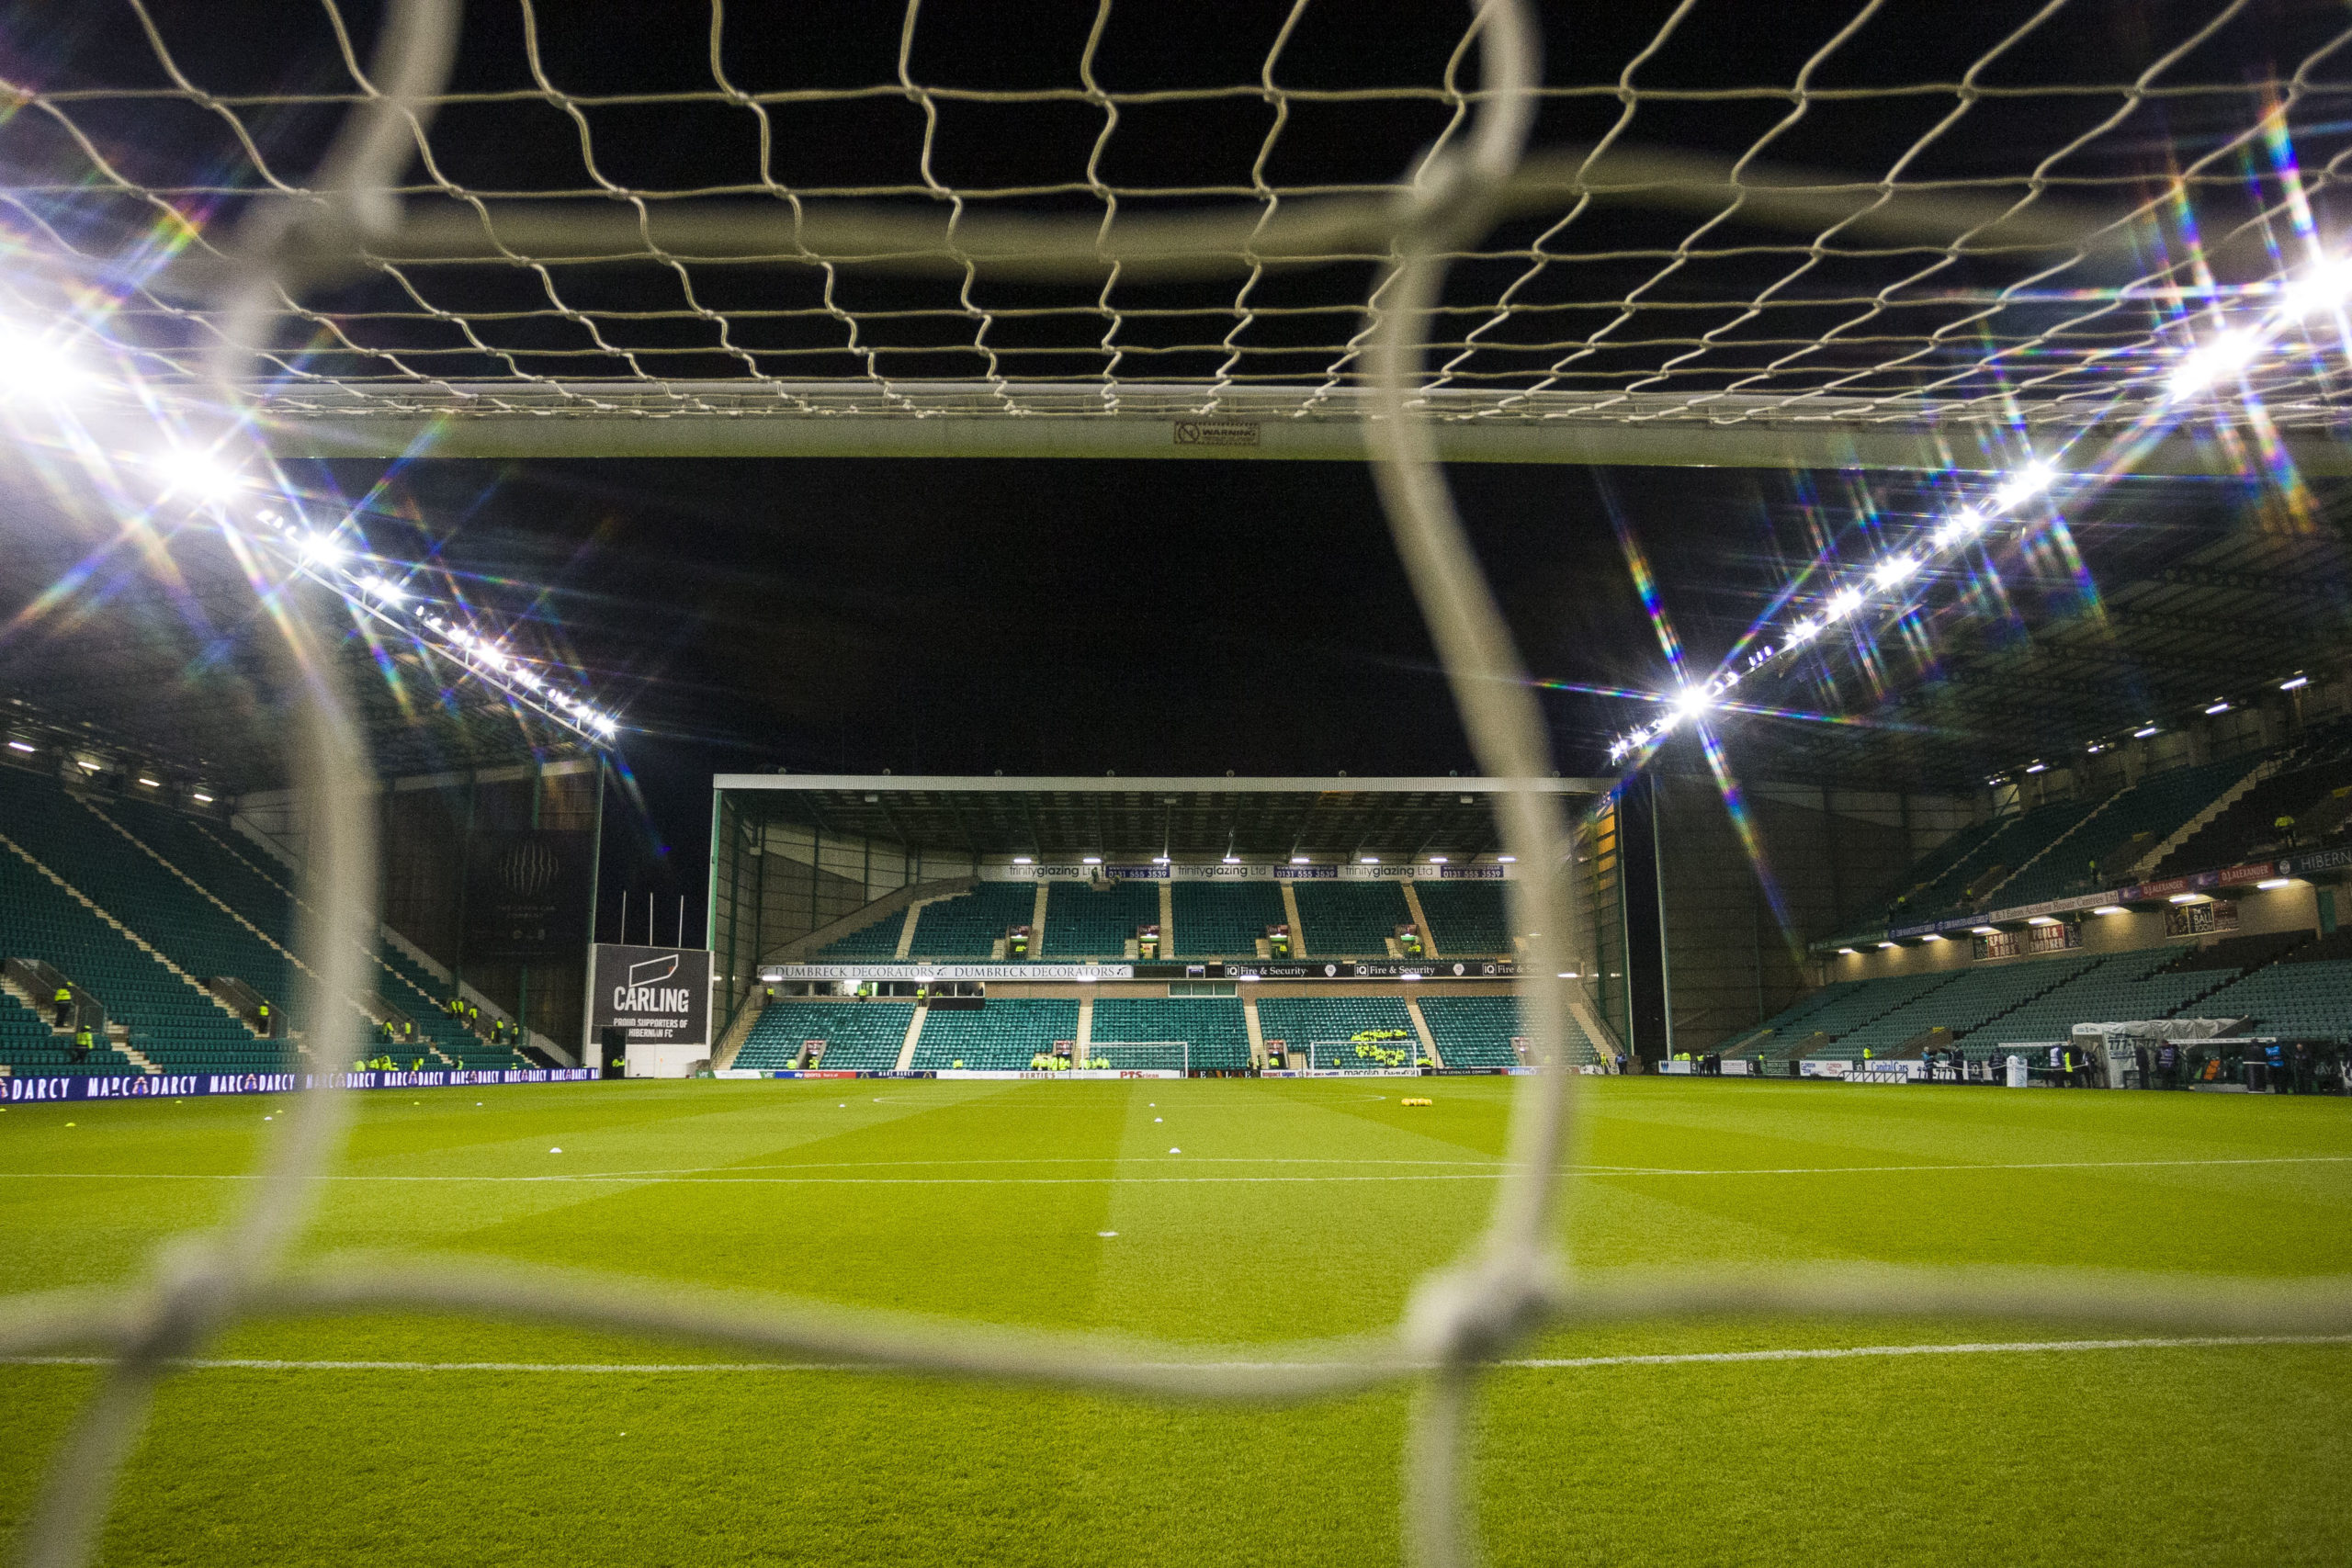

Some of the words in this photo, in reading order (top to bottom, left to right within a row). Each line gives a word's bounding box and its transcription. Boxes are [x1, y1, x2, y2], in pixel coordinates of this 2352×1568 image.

[1250, 866, 1266, 875] Ltd
[1345, 866, 1415, 877] trinityglazing
[1418, 866, 1433, 875] Ltd
[2032, 927, 2052, 940] POOL
[775, 966, 848, 977] DUMBRECK
[852, 967, 934, 977] DECORATORS
[955, 966, 1028, 977] DUMBRECK
[1032, 967, 1114, 977] DECORATORS
[1240, 966, 1258, 976] Fire
[1260, 966, 1267, 976] &
[1270, 966, 1306, 977] Security
[1370, 965, 1386, 975] Fire
[1389, 966, 1396, 975] &
[1398, 965, 1435, 976] Security
[1498, 965, 1514, 975] Fire
[614, 986, 689, 1012] CARLING
[613, 1018, 636, 1027] PROUD
[637, 1018, 678, 1028] SUPPORTERS
[679, 1020, 688, 1028] OF
[628, 1028, 663, 1038] HIBERNIAN
[664, 1029, 673, 1038] FC
[1871, 1059, 1894, 1072] Capital
[1894, 1061, 1909, 1072] Cars
[346, 1072, 377, 1089] DARCY
[384, 1071, 408, 1087] MARC
[418, 1071, 444, 1087] DARCY
[450, 1071, 469, 1085] MARC
[478, 1070, 500, 1084] DARCY
[504, 1070, 521, 1083] MARC
[528, 1069, 547, 1082] DARCY
[551, 1068, 566, 1081] MARC
[571, 1068, 587, 1080] DARCY
[11, 1077, 71, 1100] DARCY
[87, 1077, 131, 1097] MARC
[151, 1076, 198, 1096] DARCY
[209, 1075, 243, 1093] MARC
[258, 1074, 295, 1092] DARCY
